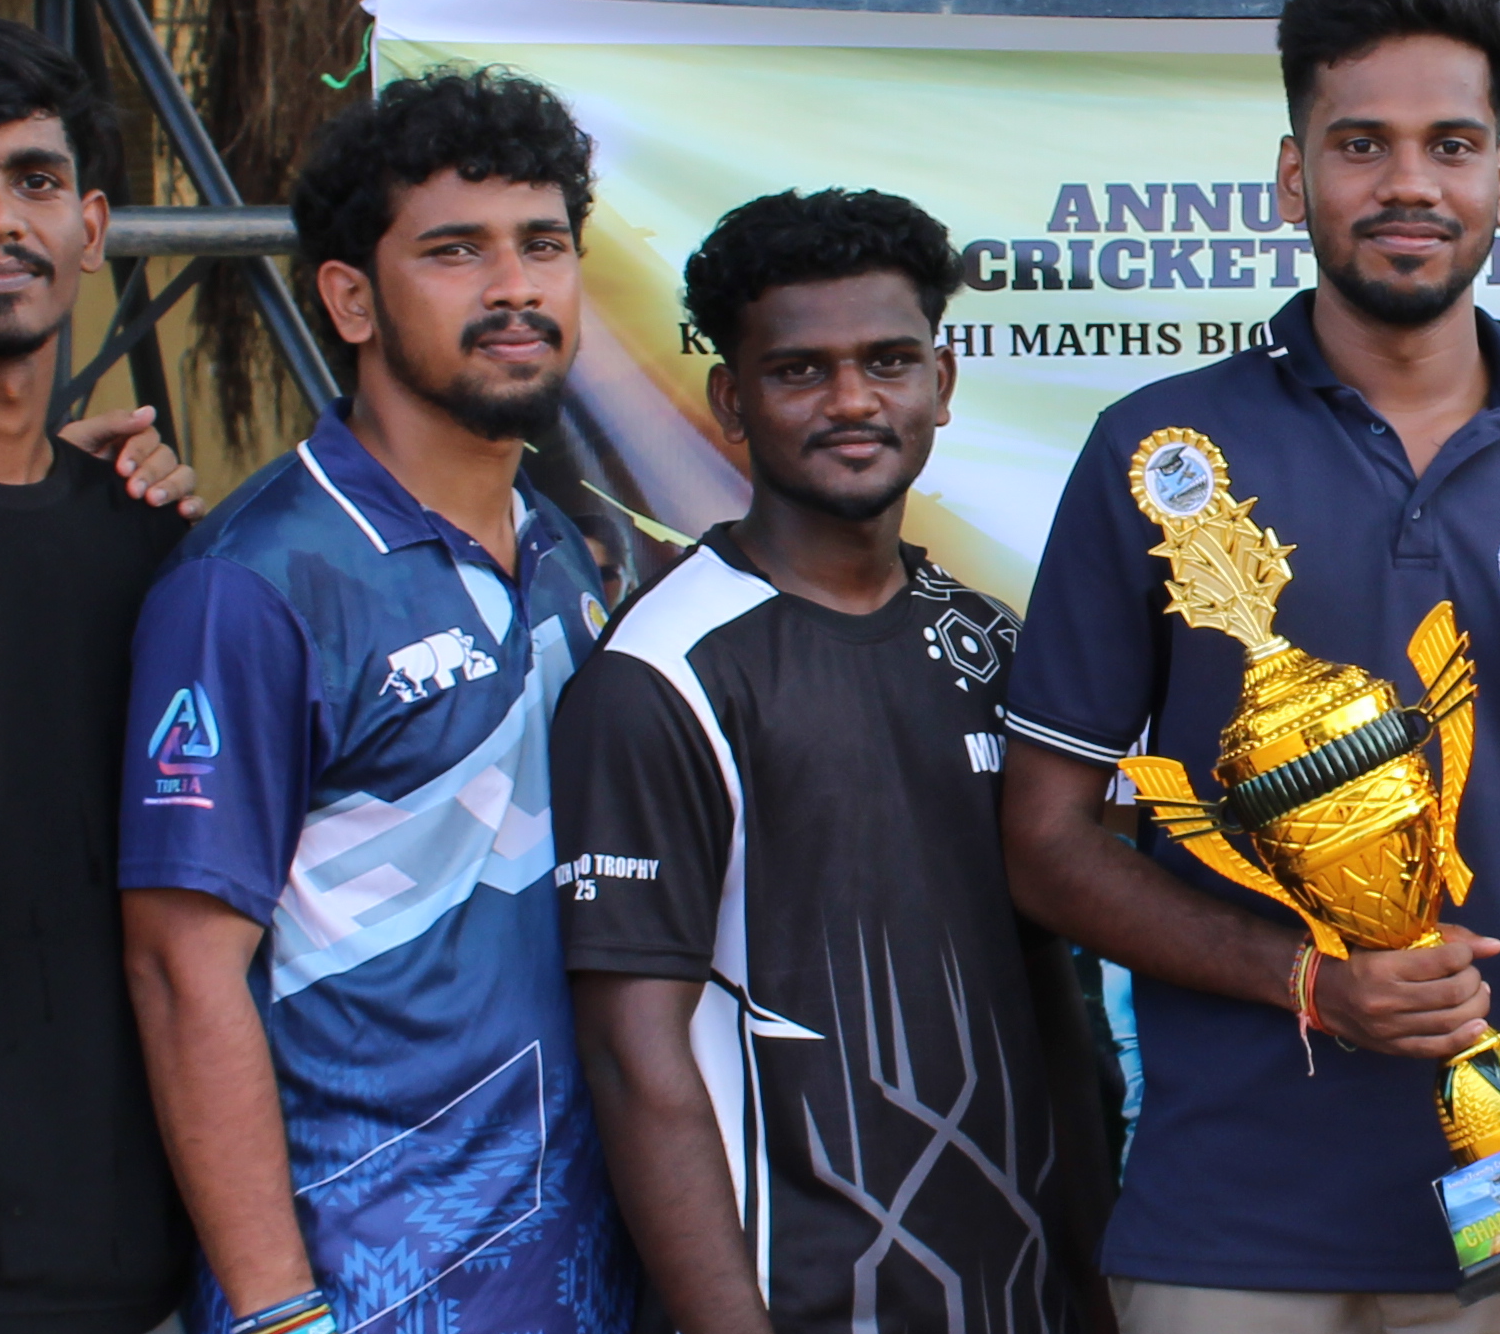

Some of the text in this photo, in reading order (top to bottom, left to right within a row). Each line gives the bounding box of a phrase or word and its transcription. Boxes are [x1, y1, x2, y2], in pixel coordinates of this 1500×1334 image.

[961, 238, 1317, 291] CRICKET
[1009, 321, 1182, 357] MATHS
[594, 853, 659, 880] TROPHY
[574, 879, 597, 901] 25
